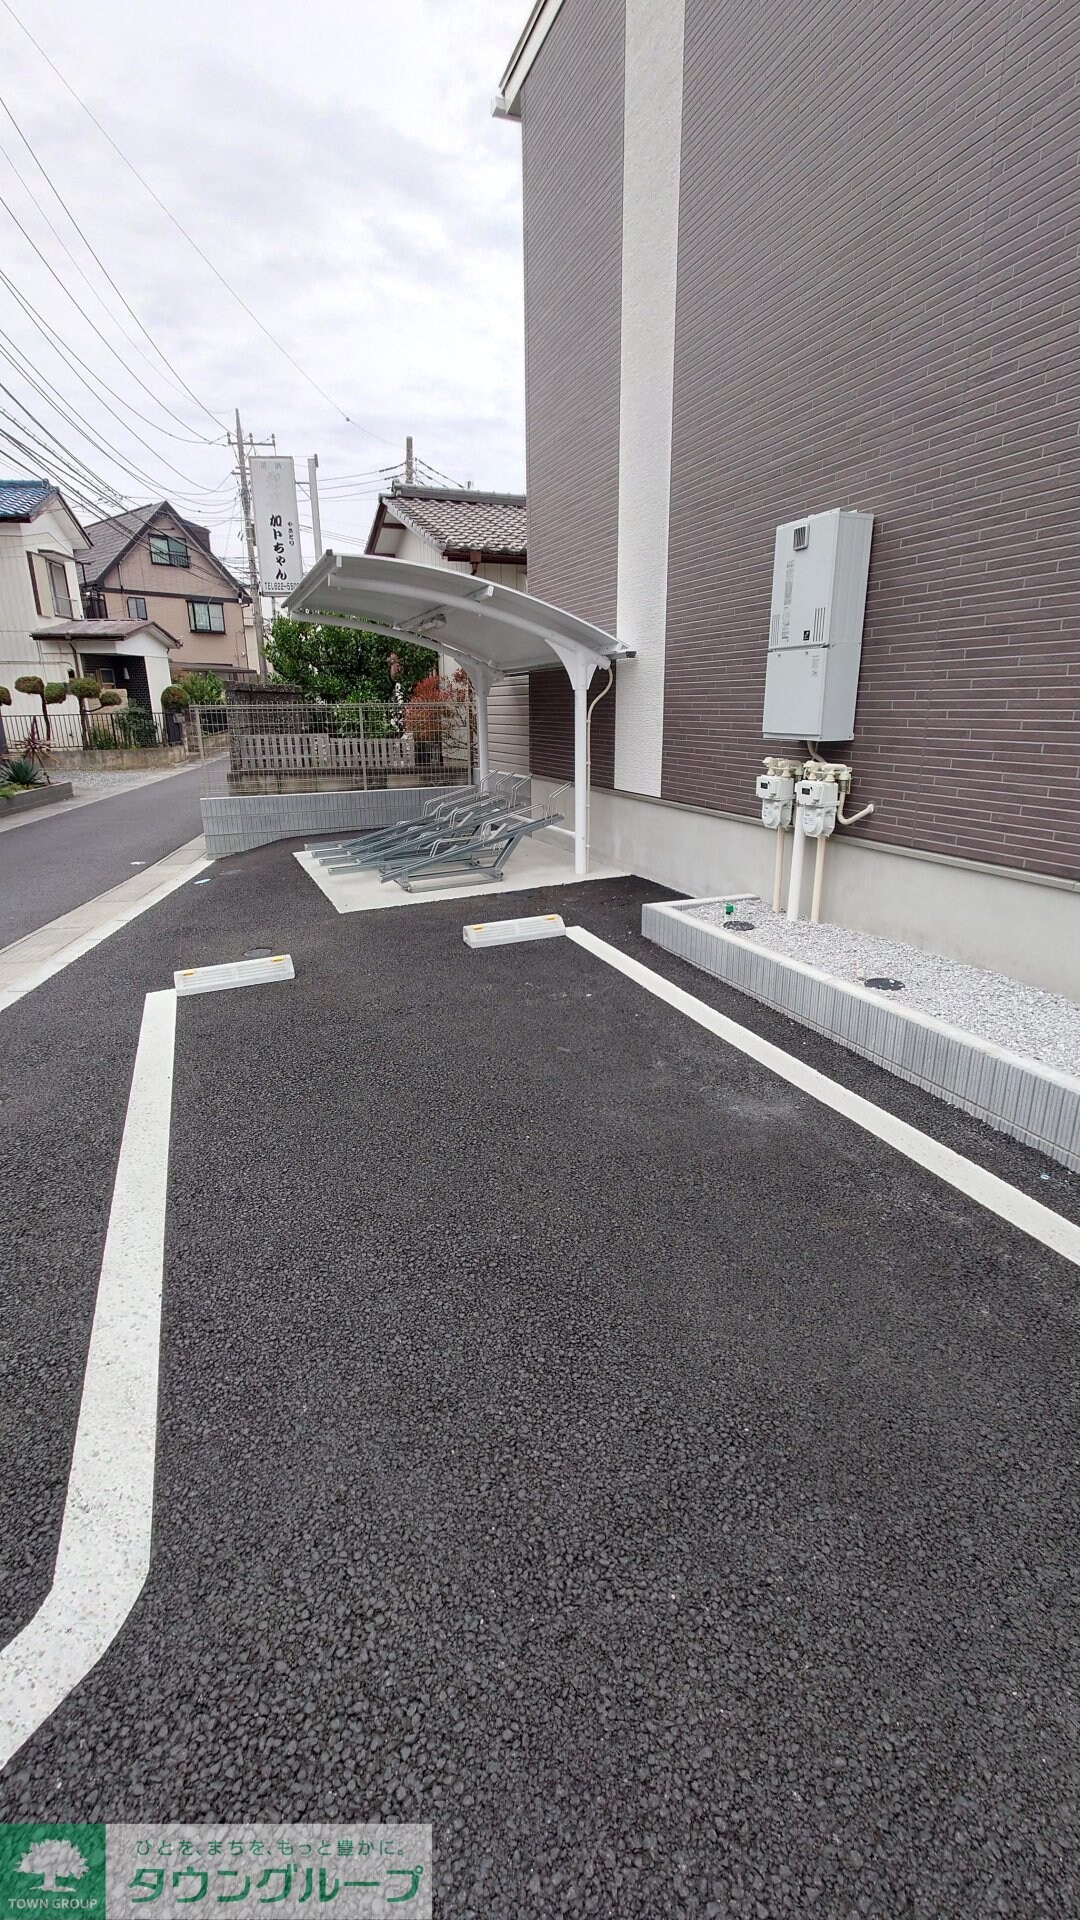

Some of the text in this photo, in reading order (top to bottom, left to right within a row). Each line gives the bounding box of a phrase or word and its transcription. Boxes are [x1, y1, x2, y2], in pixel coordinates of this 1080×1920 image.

[269, 514, 287, 580] 加トちゃん
